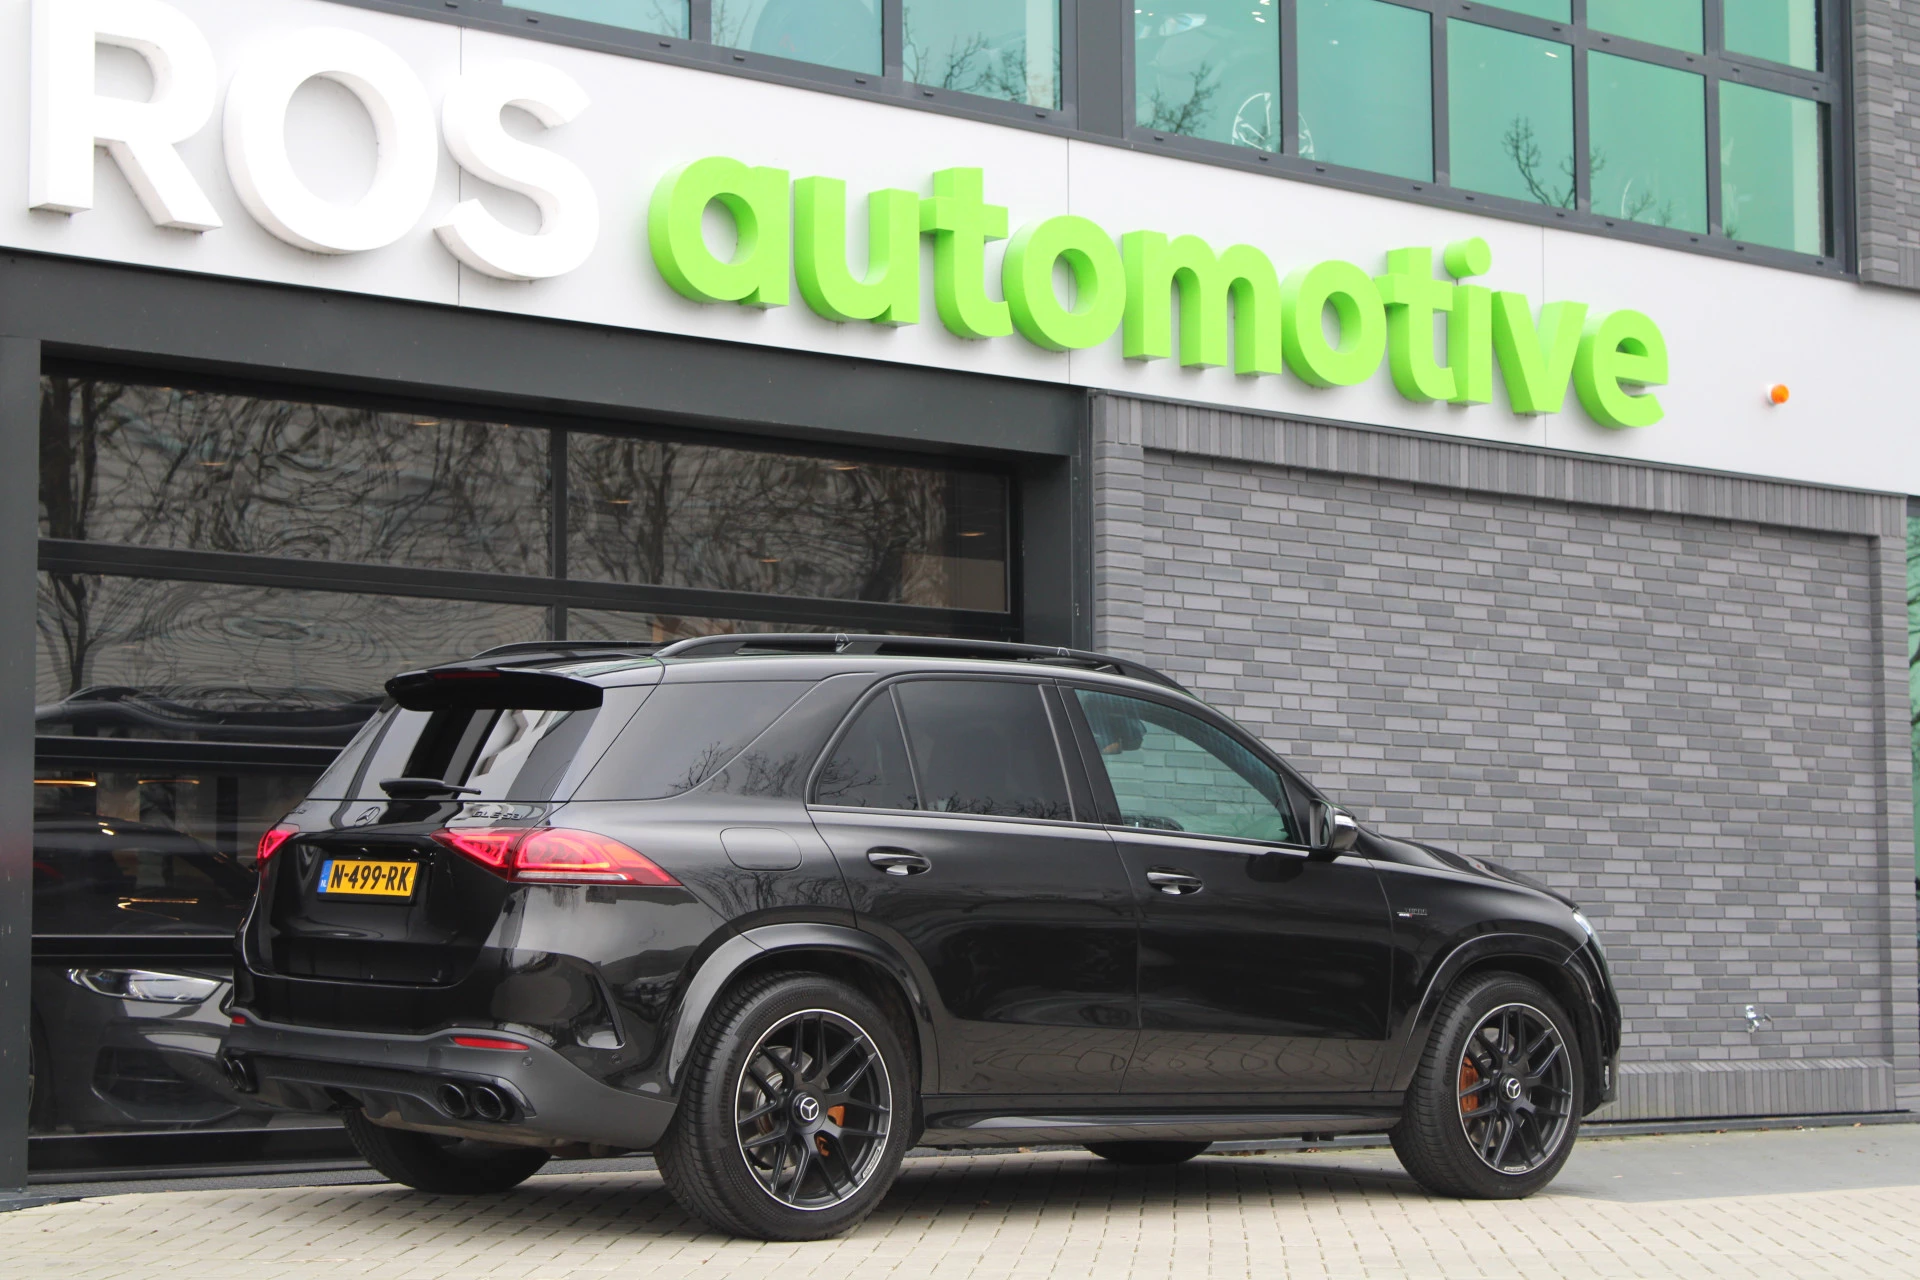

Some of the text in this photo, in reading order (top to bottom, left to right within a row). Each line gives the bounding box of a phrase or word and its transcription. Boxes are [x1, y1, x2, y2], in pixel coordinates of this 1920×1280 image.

[28, 0, 600, 282] ROS
[648, 156, 1669, 431] automotive
[330, 864, 412, 892] N-499-RK
